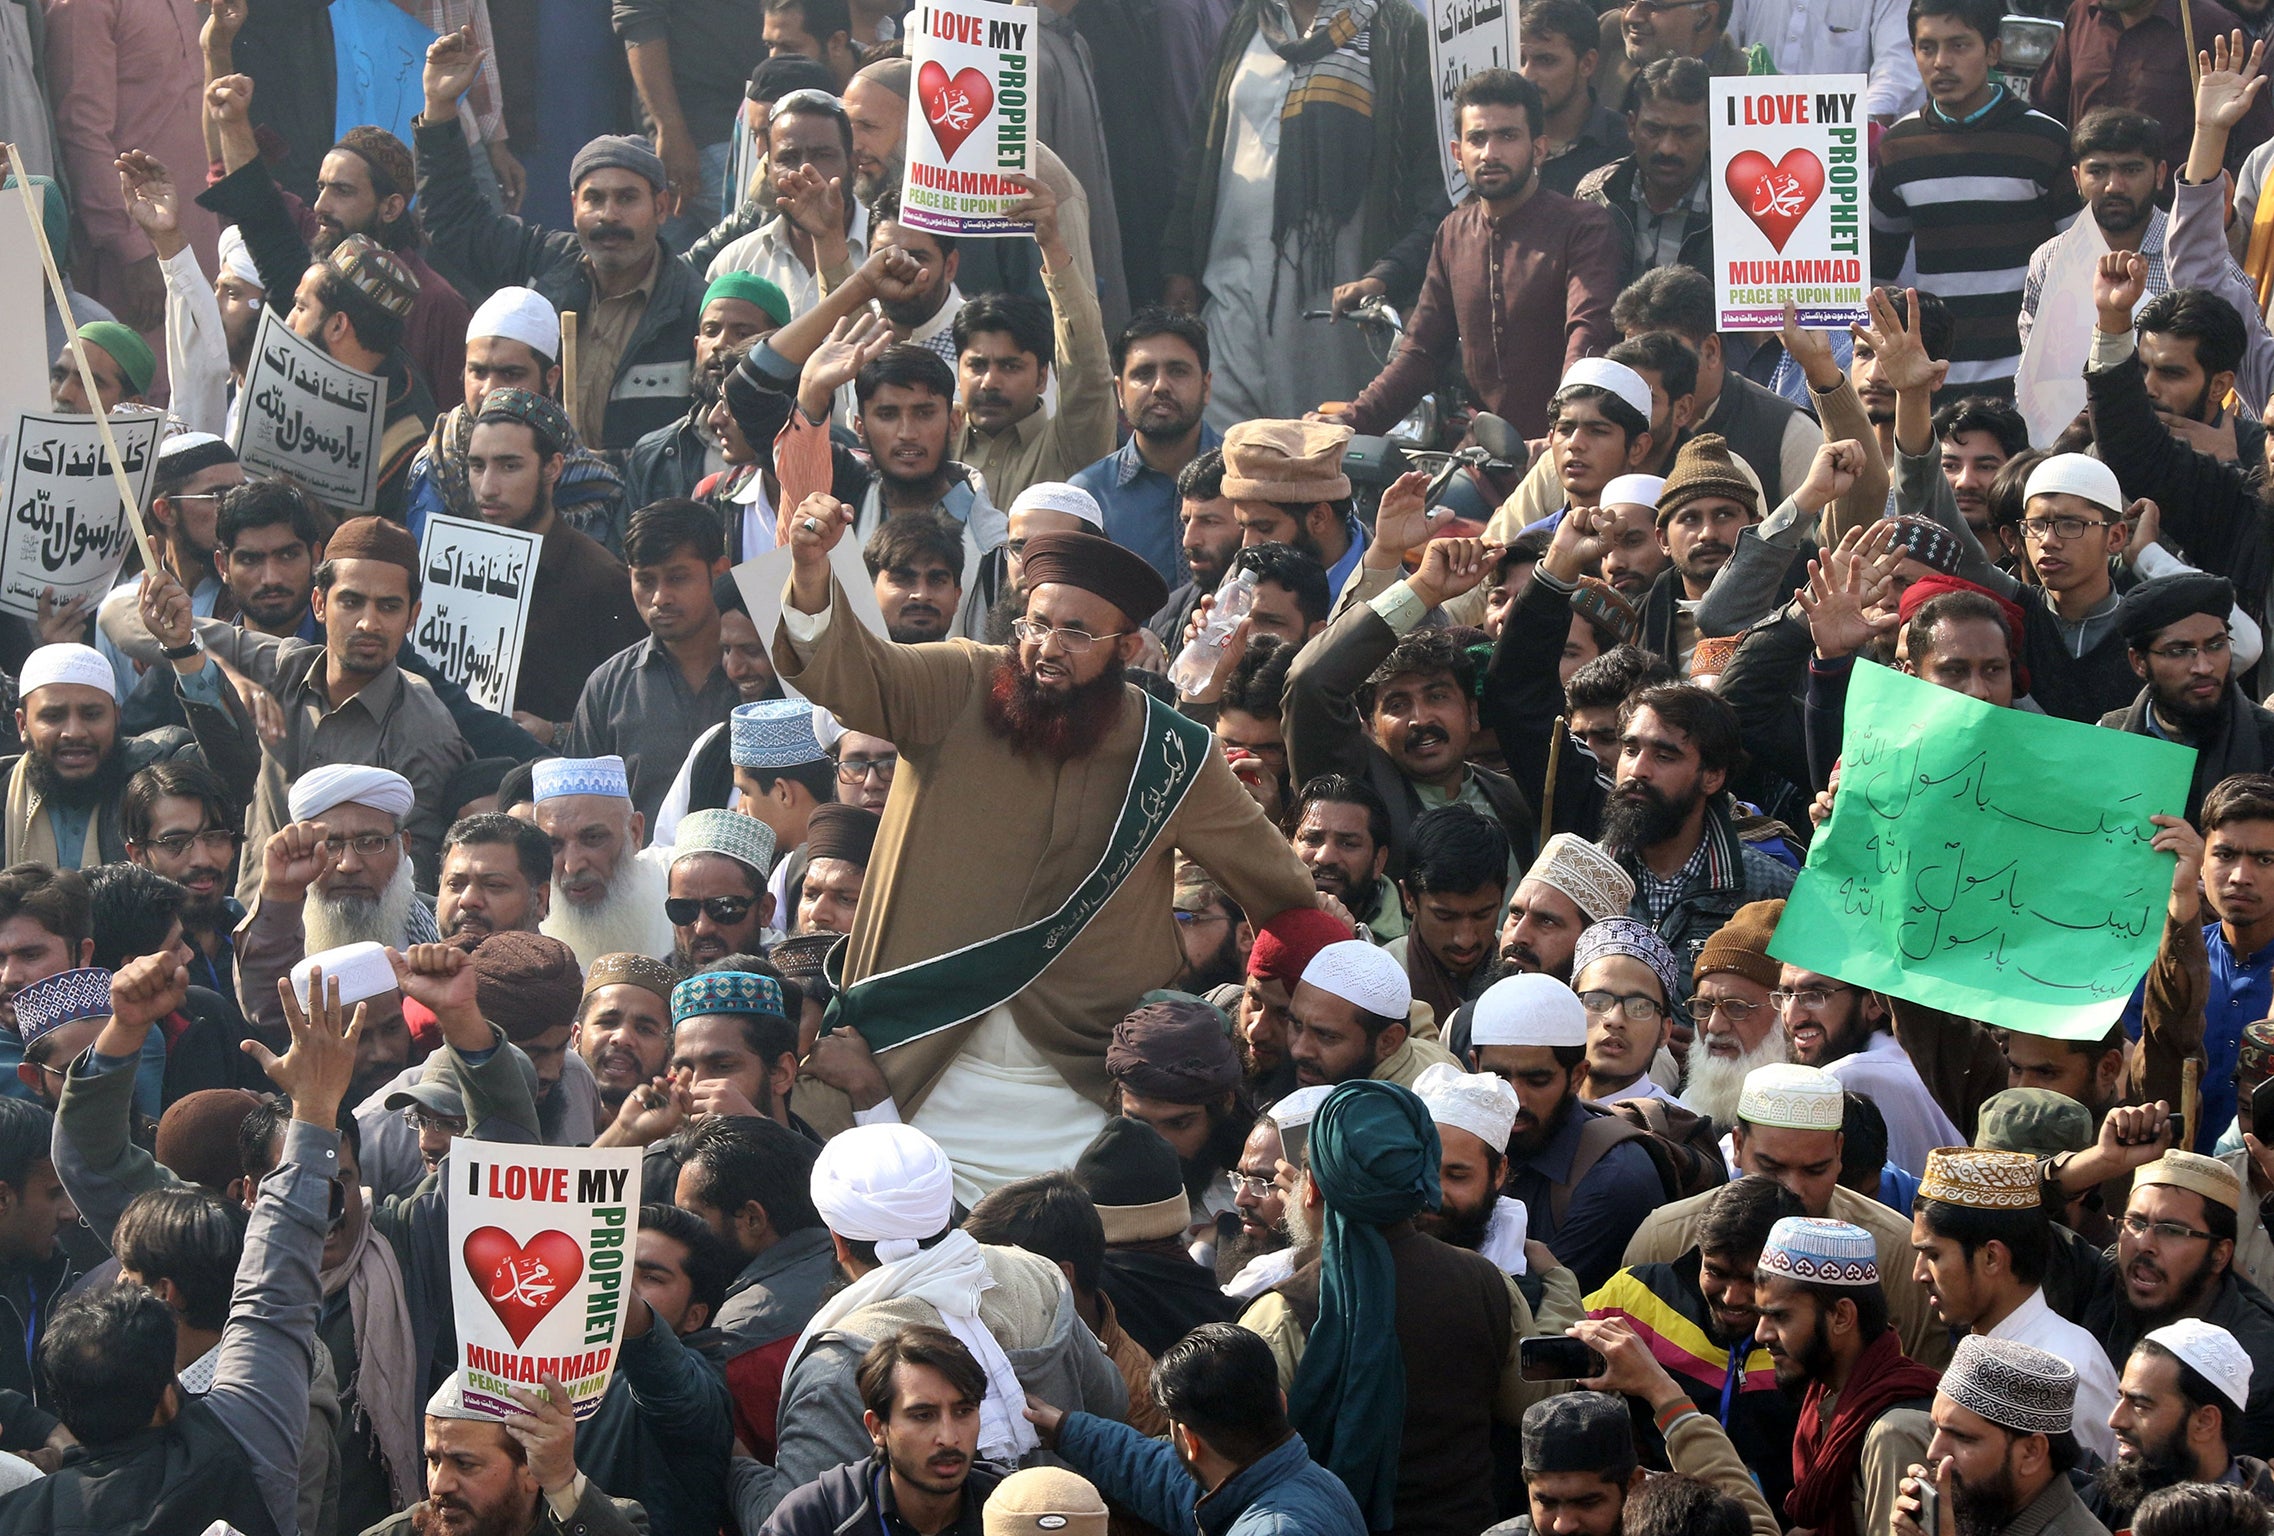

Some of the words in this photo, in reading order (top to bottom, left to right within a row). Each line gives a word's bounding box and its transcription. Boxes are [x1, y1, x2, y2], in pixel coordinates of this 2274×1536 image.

[923, 6, 929, 34] I
[933, 9, 983, 46] LOVE
[989, 20, 1028, 51] MY
[998, 53, 1027, 170] PROPHET
[1727, 96, 1736, 126] I
[1744, 94, 1810, 126] LOVE
[1816, 93, 1857, 124] MY
[909, 188, 940, 208] PEACE
[942, 196, 958, 211] BE
[961, 198, 997, 213] UPON
[1828, 128, 1859, 255] PROPHET
[1729, 259, 1861, 285] MUHAMMAD
[1730, 288, 1773, 304] PEACE
[1777, 287, 1794, 304] BE
[1797, 287, 1831, 304] UPON
[1835, 287, 1861, 303] HIM
[469, 1162, 479, 1196] I
[489, 1164, 568, 1203] LOVE
[577, 1169, 630, 1203] MY
[584, 1207, 627, 1346] PROPHET
[466, 1342, 612, 1384] MUHAMMAD
[578, 1374, 606, 1397] HIM
